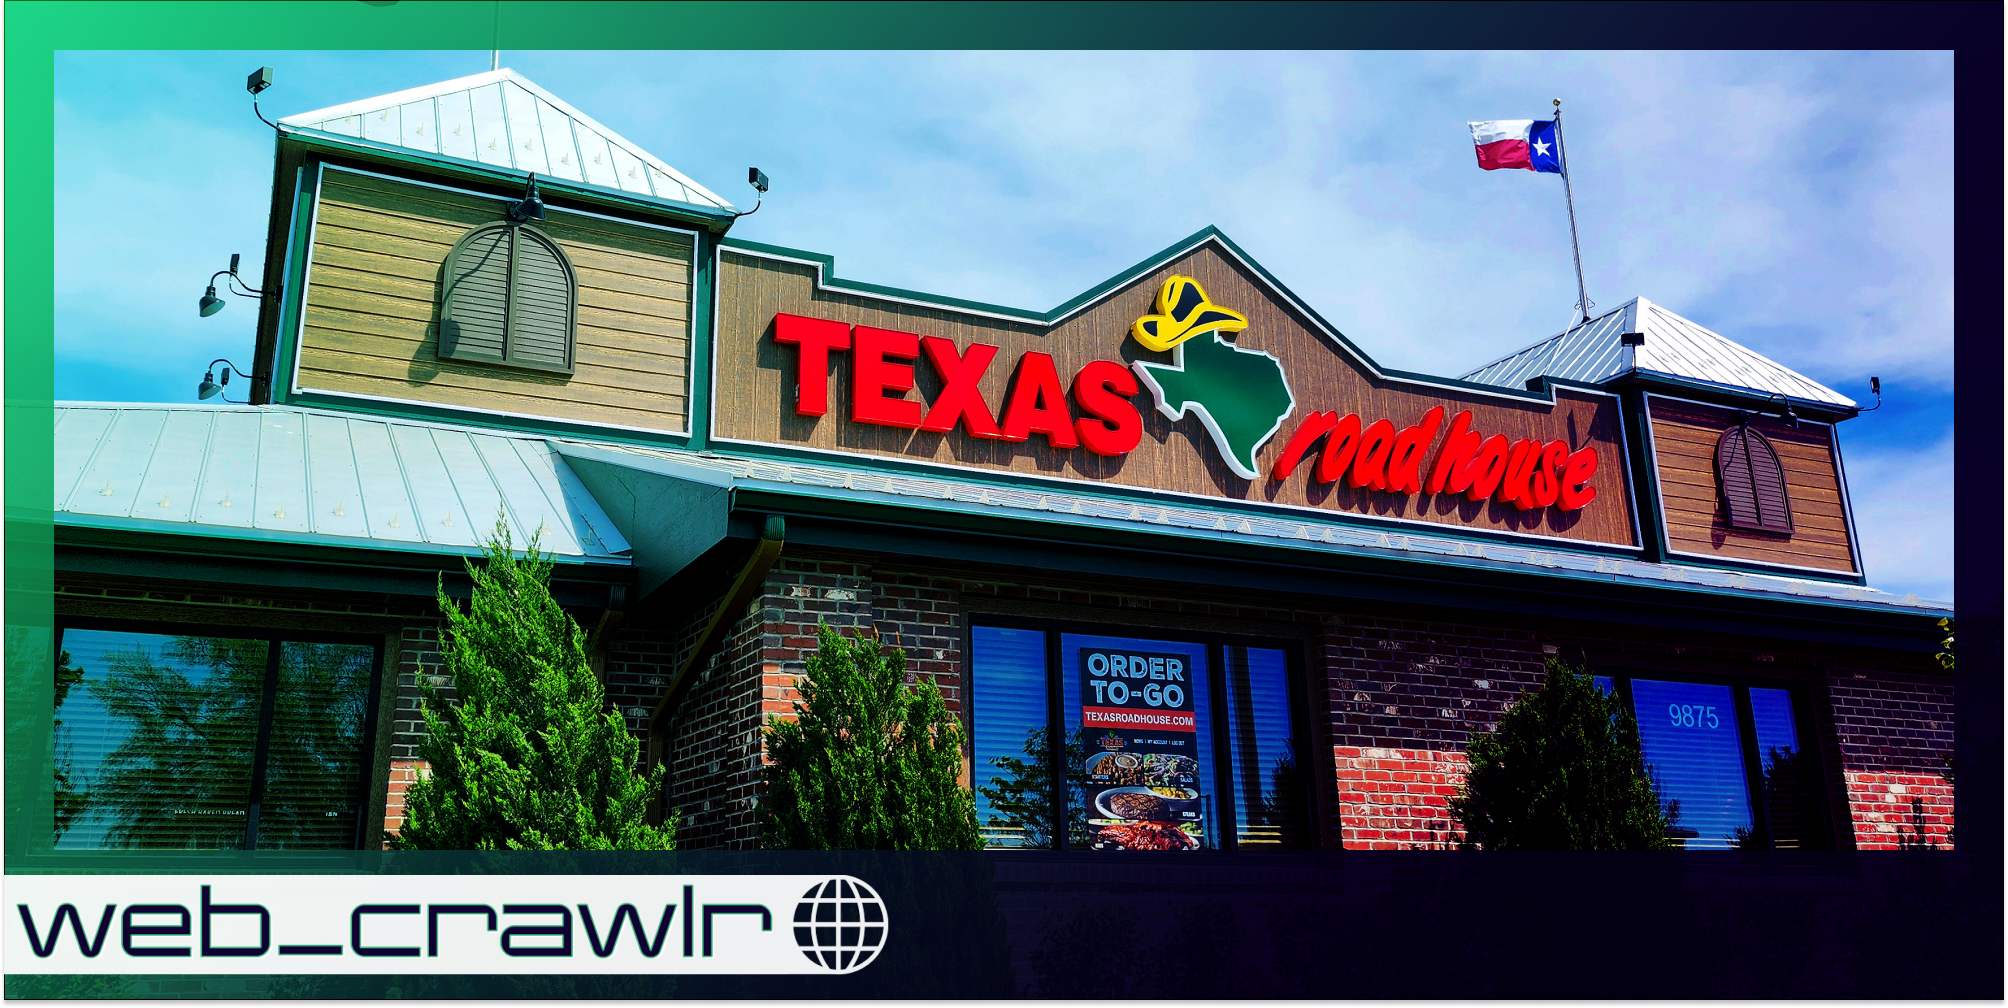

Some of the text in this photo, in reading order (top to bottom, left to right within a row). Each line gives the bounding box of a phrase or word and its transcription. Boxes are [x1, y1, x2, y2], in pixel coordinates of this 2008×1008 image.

[774, 312, 1144, 457] TEXAS
[1087, 653, 1185, 682] ORDER
[1090, 680, 1184, 708] TO-GO
[1085, 711, 1194, 726] TEXASROADHOUSE.COM
[1668, 703, 1720, 729] 9875
[1101, 738, 1123, 746] TEXAS
